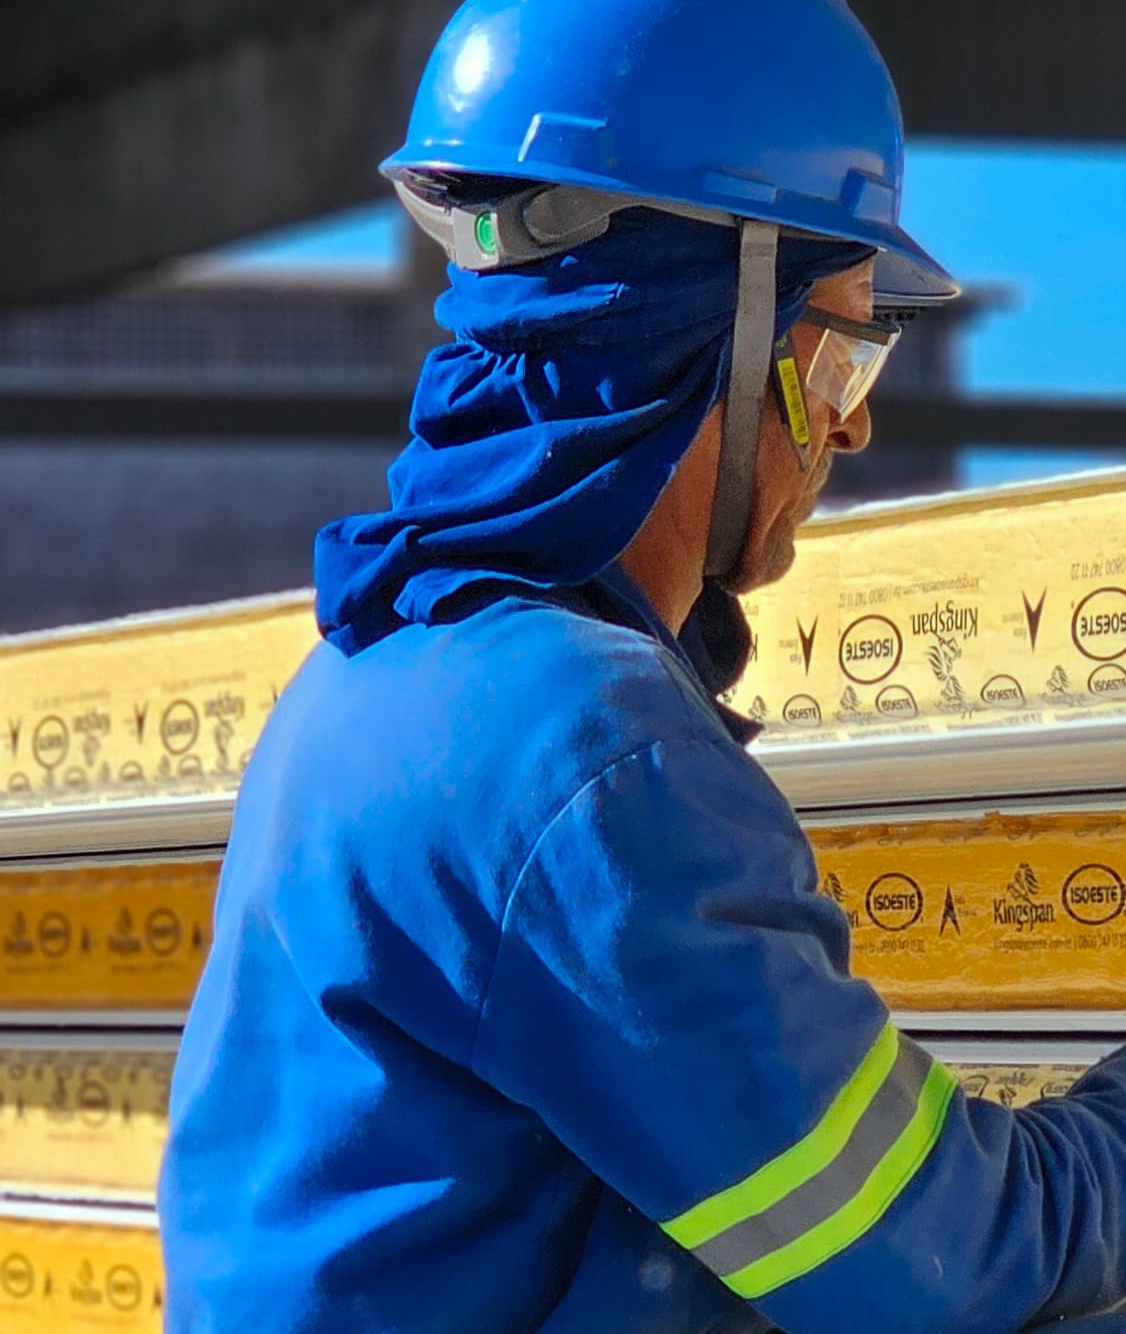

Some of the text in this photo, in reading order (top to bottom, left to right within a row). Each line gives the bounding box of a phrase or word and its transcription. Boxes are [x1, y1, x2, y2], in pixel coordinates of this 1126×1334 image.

[912, 600, 978, 640] Kingspan
[846, 638, 893, 661] ISOESTE
[986, 687, 1018, 701] ISOESTE
[874, 893, 916, 911] ISOESTE
[1070, 886, 1118, 904] ISOESTE
[994, 897, 1054, 931] Kingspan
